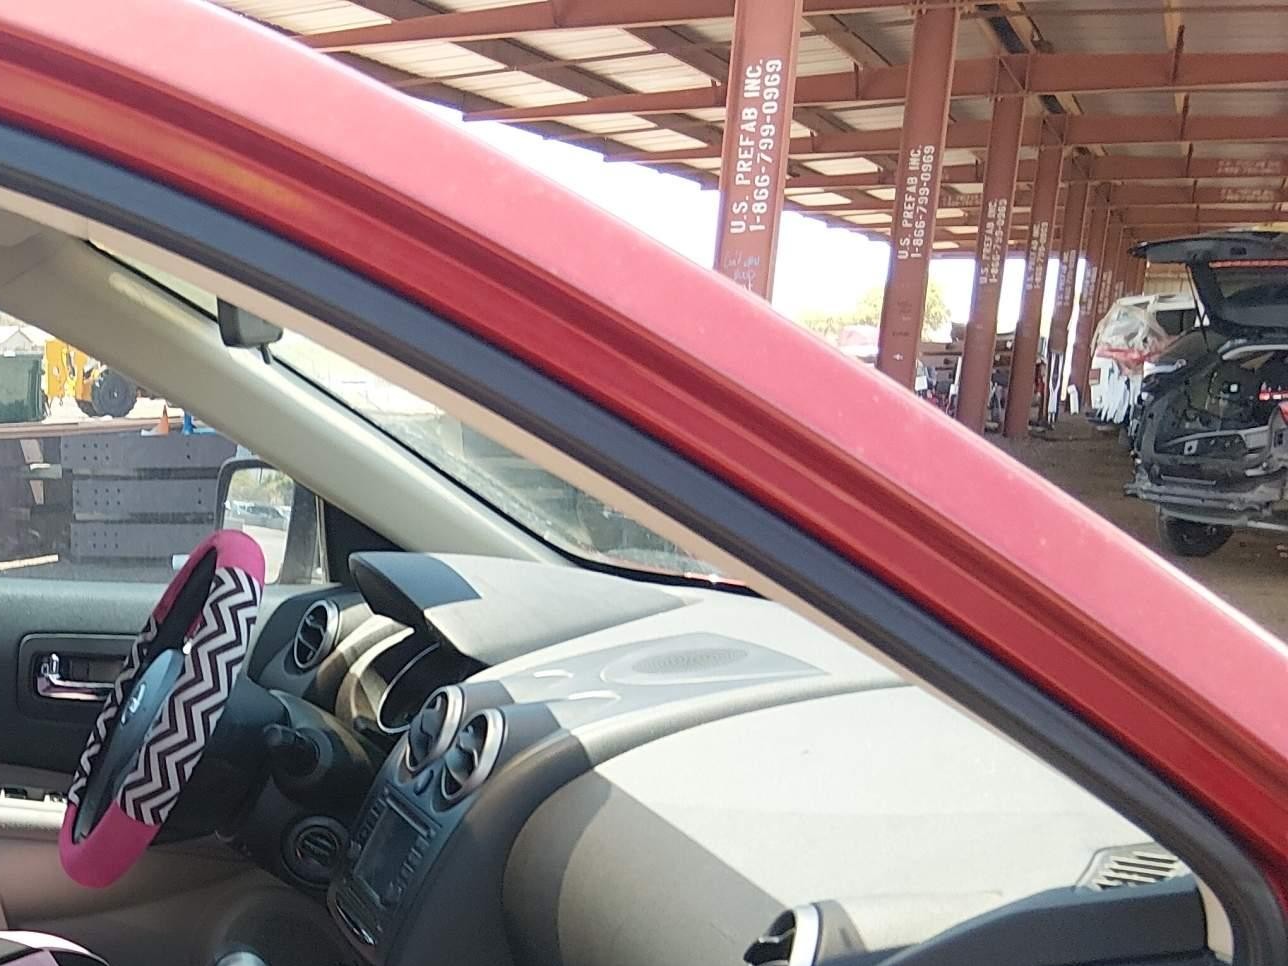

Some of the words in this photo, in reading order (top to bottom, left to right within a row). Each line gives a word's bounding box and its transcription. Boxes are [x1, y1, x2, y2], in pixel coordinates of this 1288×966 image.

[743, 58, 763, 98] INC.
[735, 106, 758, 186] PREFAB
[749, 59, 782, 233] 1-866-799-0969
[908, 144, 922, 171] INC.
[730, 196, 749, 234] U.S.
[902, 176, 918, 228] PREFAB
[910, 145, 935, 258] 1-866-799-0969
[897, 233, 911, 260] U.S.
